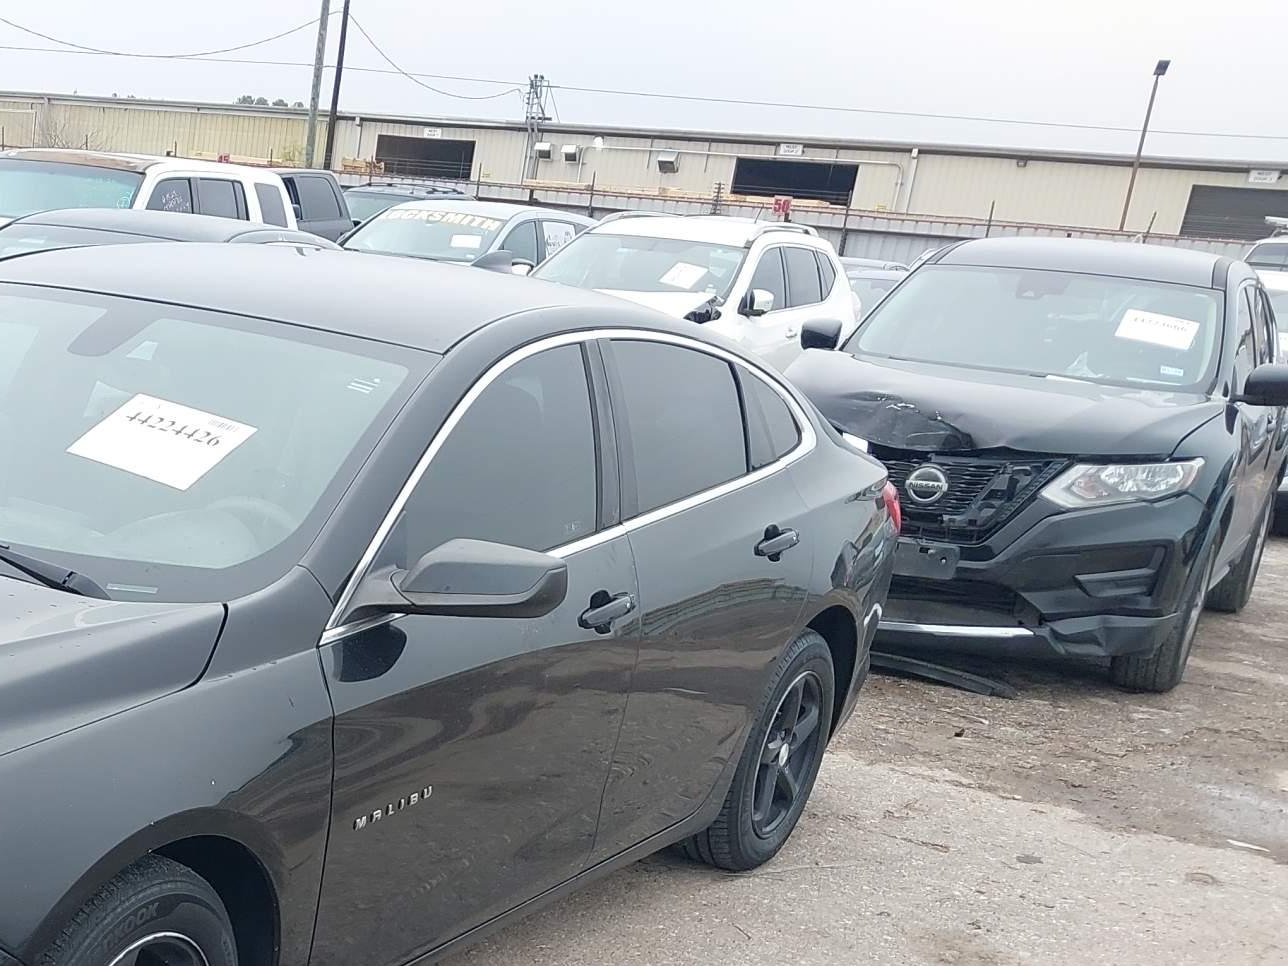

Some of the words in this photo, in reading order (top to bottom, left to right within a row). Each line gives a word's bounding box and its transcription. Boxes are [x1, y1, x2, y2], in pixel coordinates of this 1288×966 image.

[773, 199, 790, 212] 50
[381, 208, 503, 231] OCKSMITH
[125, 411, 221, 447] 44224426
[909, 481, 944, 490] NISSAN
[353, 785, 433, 832] MALIBU
